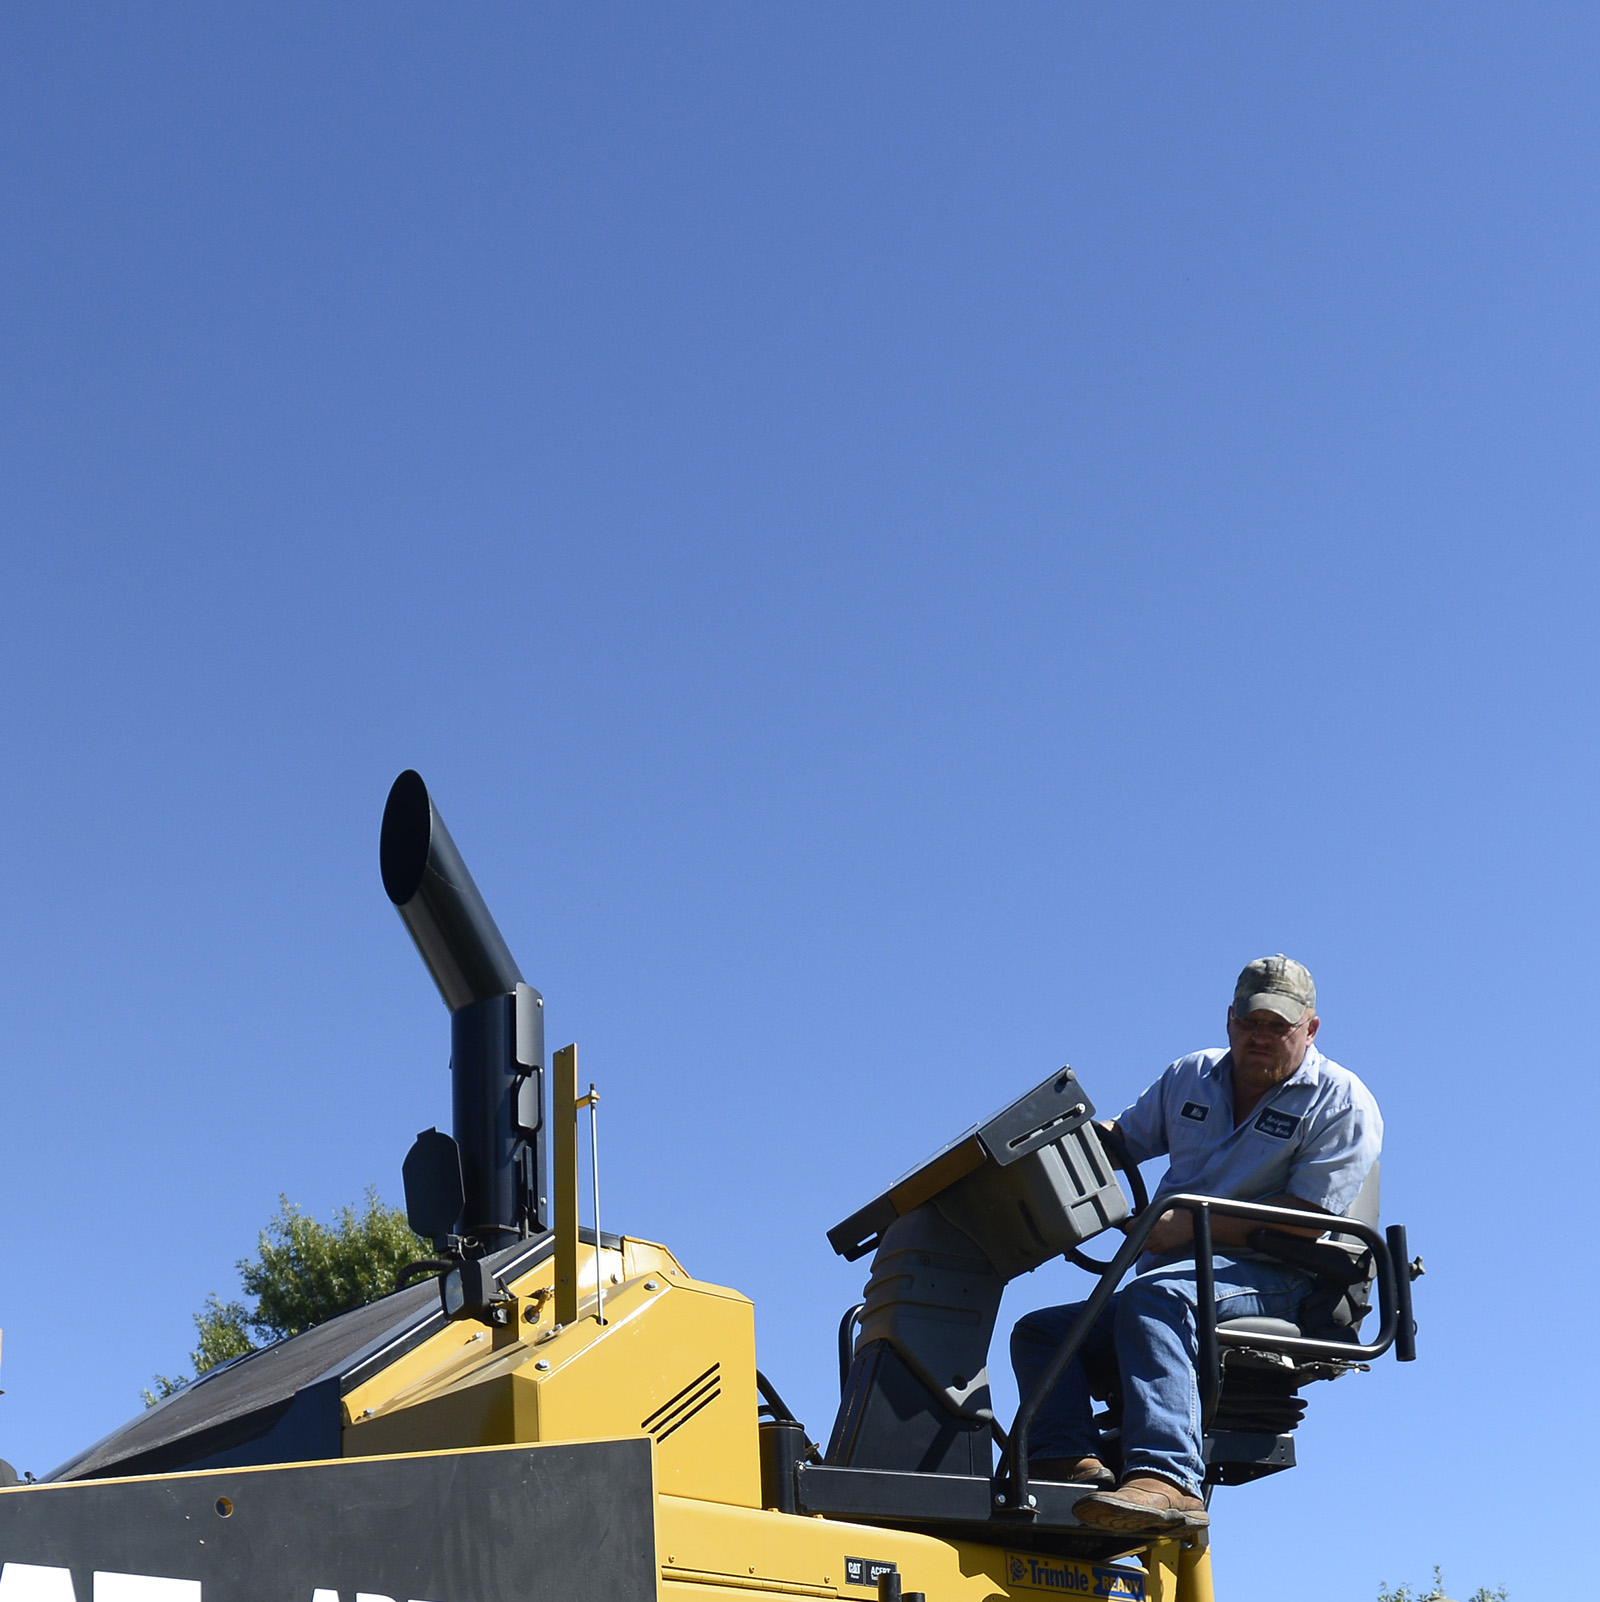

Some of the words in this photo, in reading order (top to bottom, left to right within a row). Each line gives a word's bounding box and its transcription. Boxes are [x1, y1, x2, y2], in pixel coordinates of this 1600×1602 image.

[848, 1562, 861, 1574] CAT
[1027, 1559, 1089, 1592] Trimble
[1102, 1575, 1140, 1595] READY
